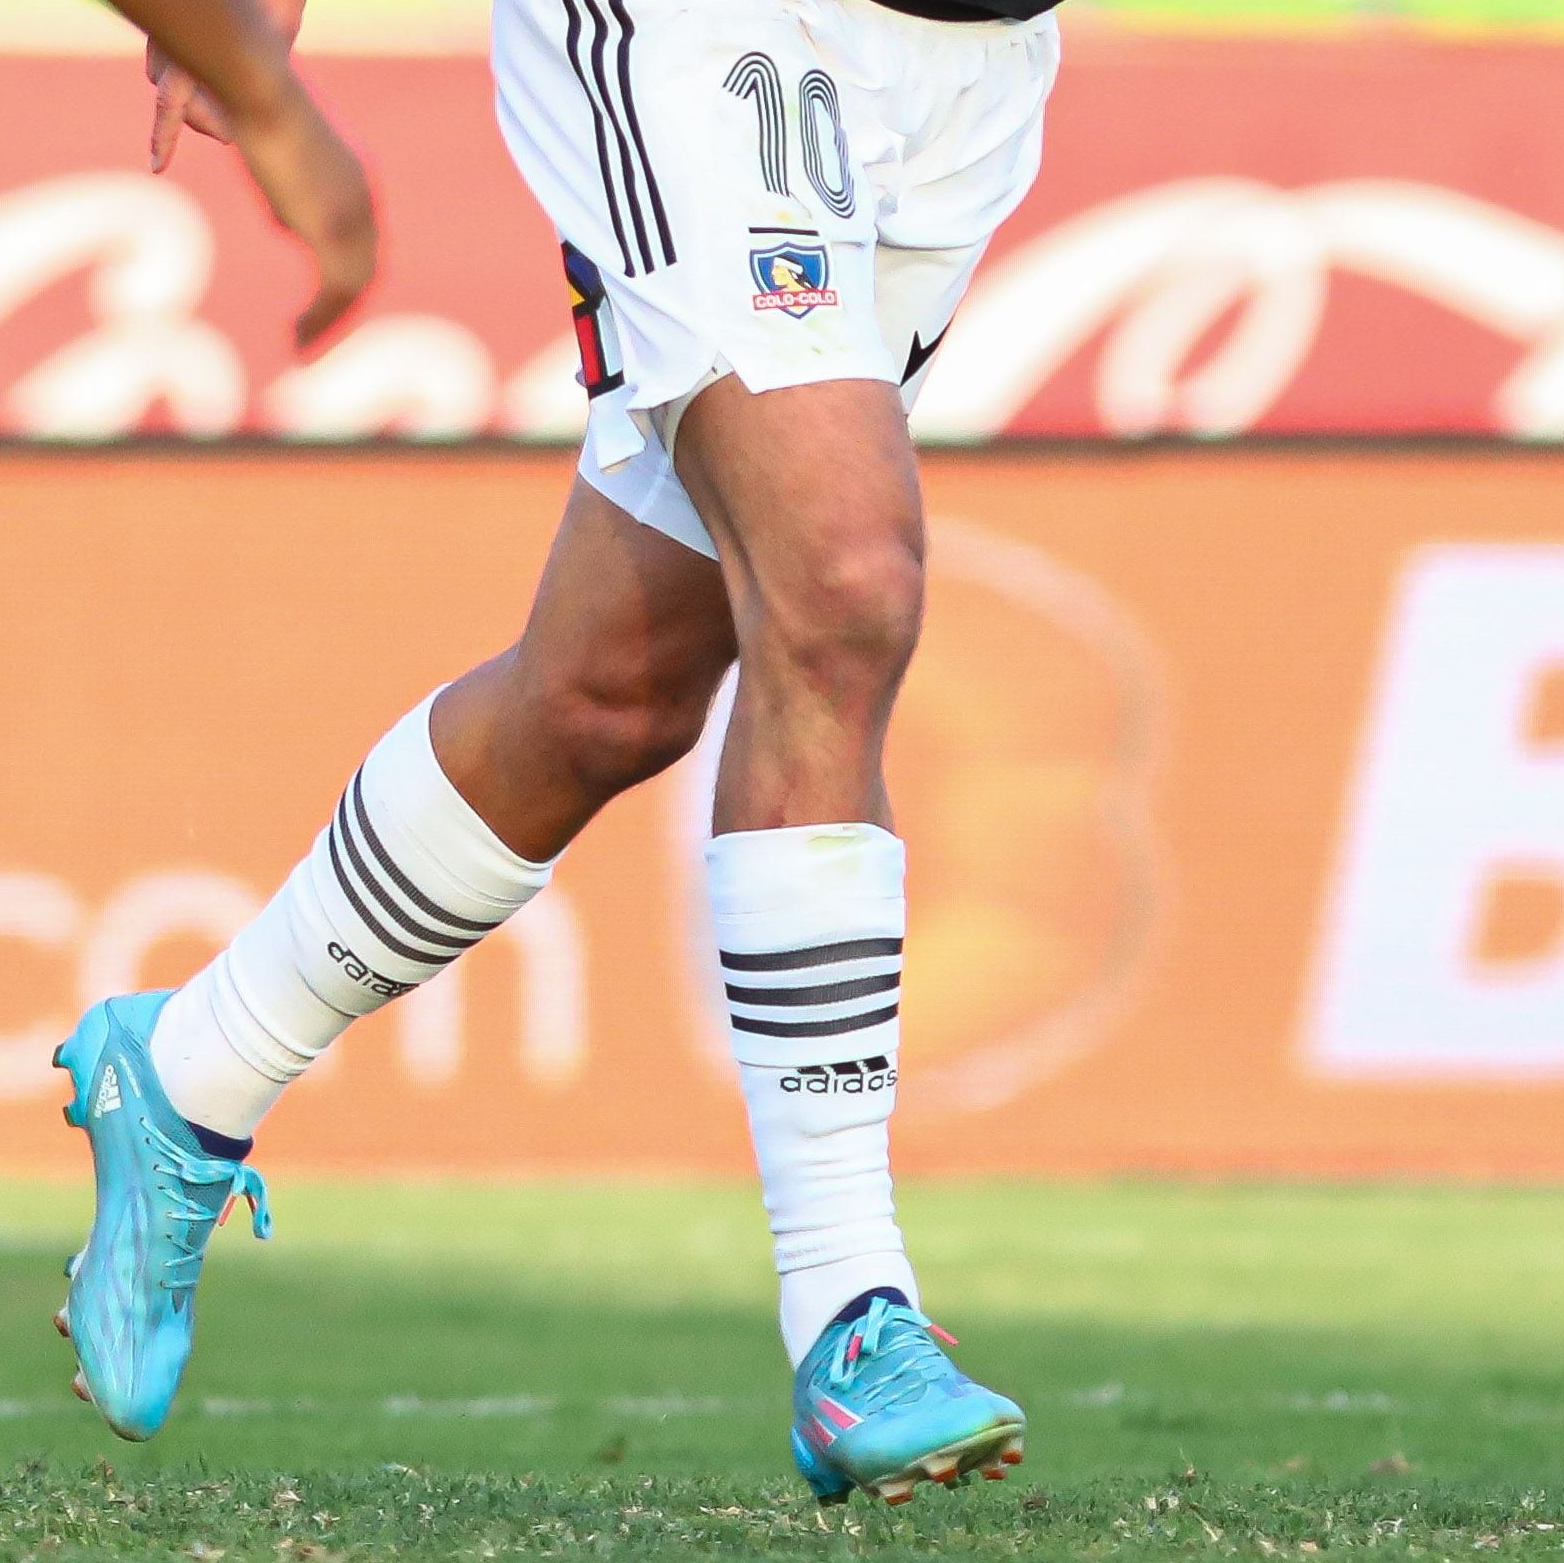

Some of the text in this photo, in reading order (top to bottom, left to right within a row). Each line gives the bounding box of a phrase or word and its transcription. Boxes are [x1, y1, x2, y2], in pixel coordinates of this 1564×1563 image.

[722, 50, 856, 219] 10
[754, 290, 837, 309] COLO-COLO
[779, 1068, 898, 1094] adidas
